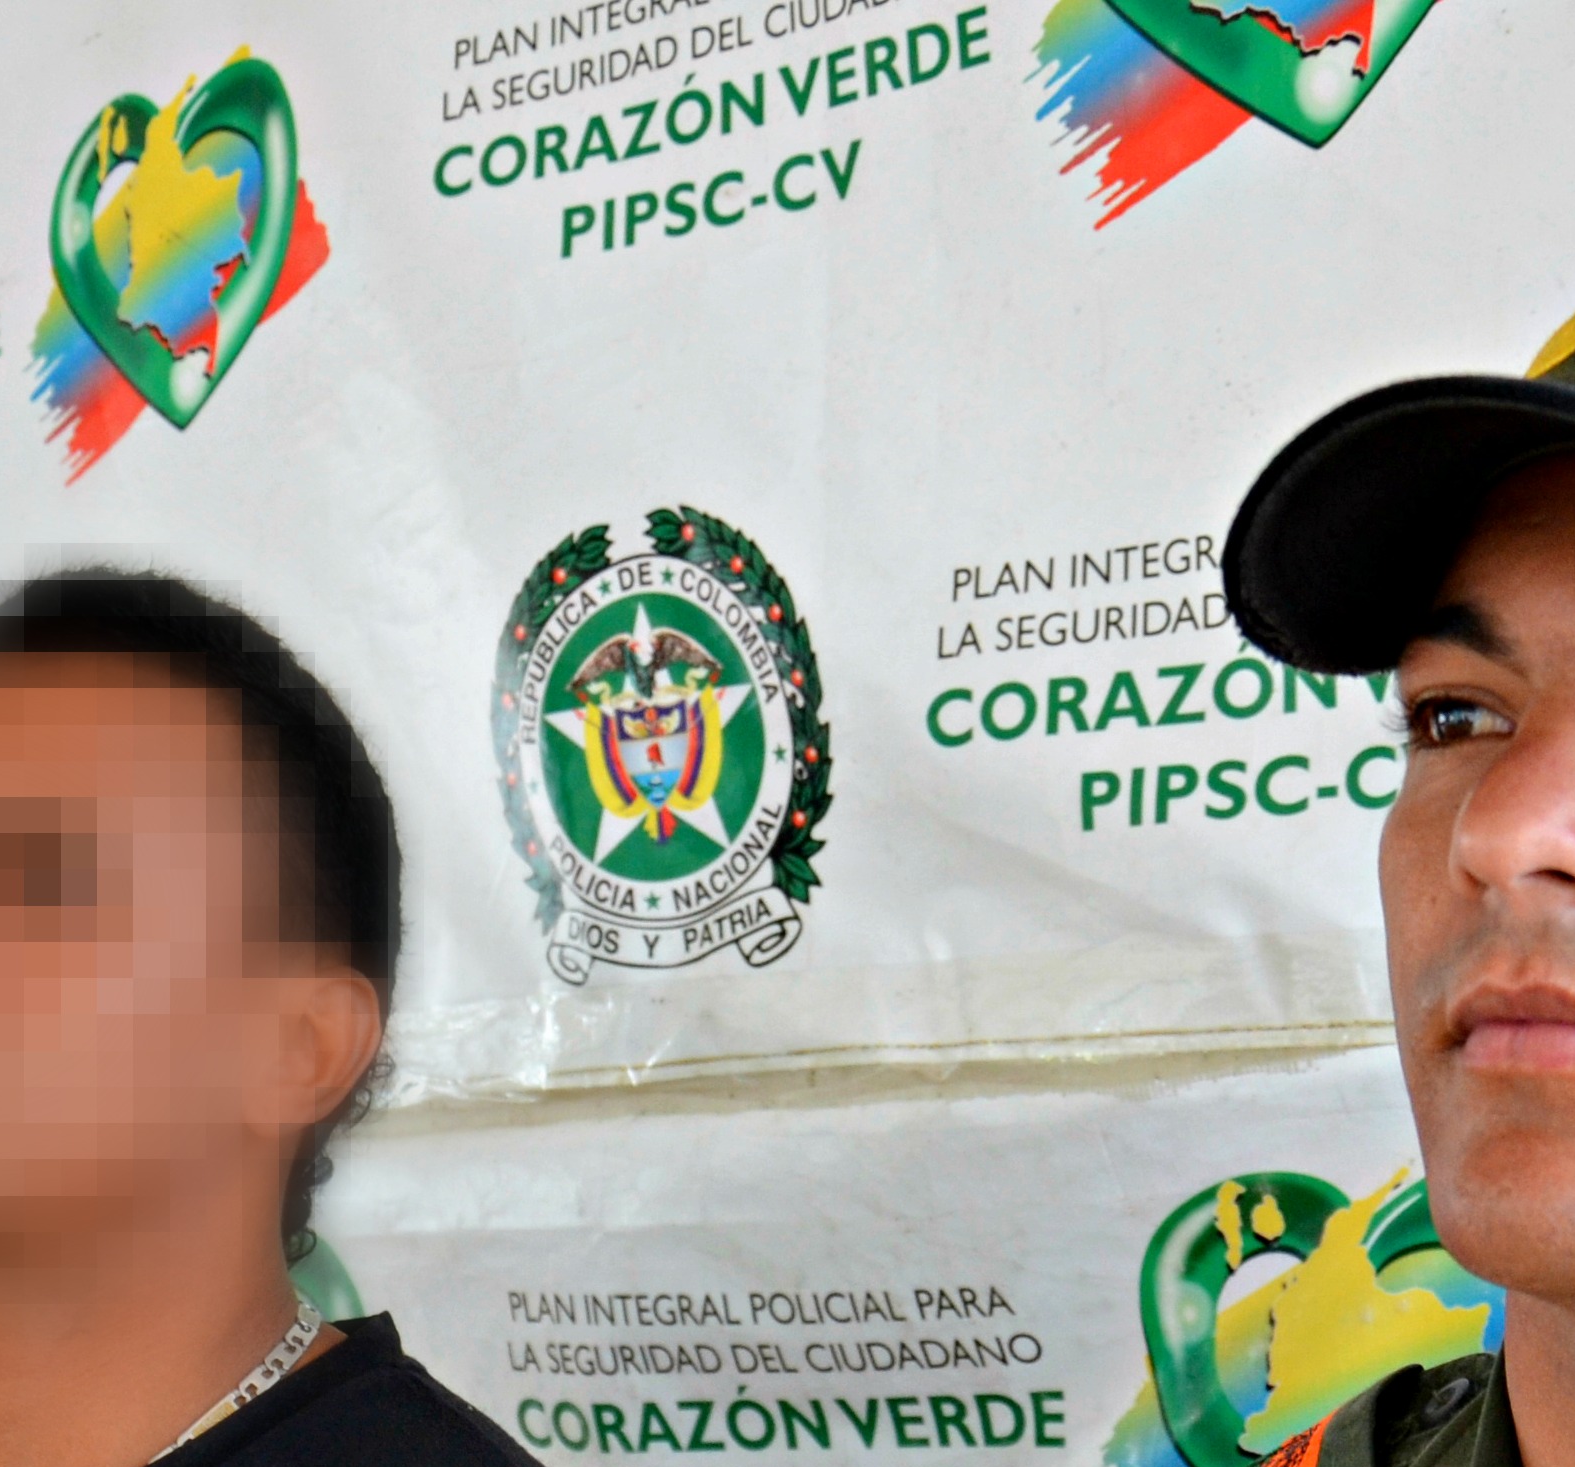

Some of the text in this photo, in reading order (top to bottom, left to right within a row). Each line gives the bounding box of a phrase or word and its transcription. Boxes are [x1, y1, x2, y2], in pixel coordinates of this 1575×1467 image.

[442, 0, 900, 122] LA SEGURIDAD DEL CIUD
[453, 0, 710, 70] PLAN INTEGR
[432, 5, 992, 198] CORAZÓN VERDE
[560, 138, 863, 259] PIPSC-CV
[951, 535, 1223, 603] PLAN INTEGR
[521, 560, 782, 746] REPUBLICA DE COLOMBIA
[937, 593, 1230, 661] LA SEGURIDAD
[925, 640, 1339, 748] CORAZÓN
[1080, 743, 1412, 832] PIPSC-C
[548, 801, 784, 914] POLICIA NACIONAL
[567, 896, 773, 959] DIOS Y PATRIA
[508, 1285, 1017, 1327] PLAN INTEGRAL POLICIAL PARA
[507, 1332, 1044, 1377] LA SEGURIDAD DEL CIUDADANO
[516, 1384, 1067, 1455] CORAZÓN VERDE
